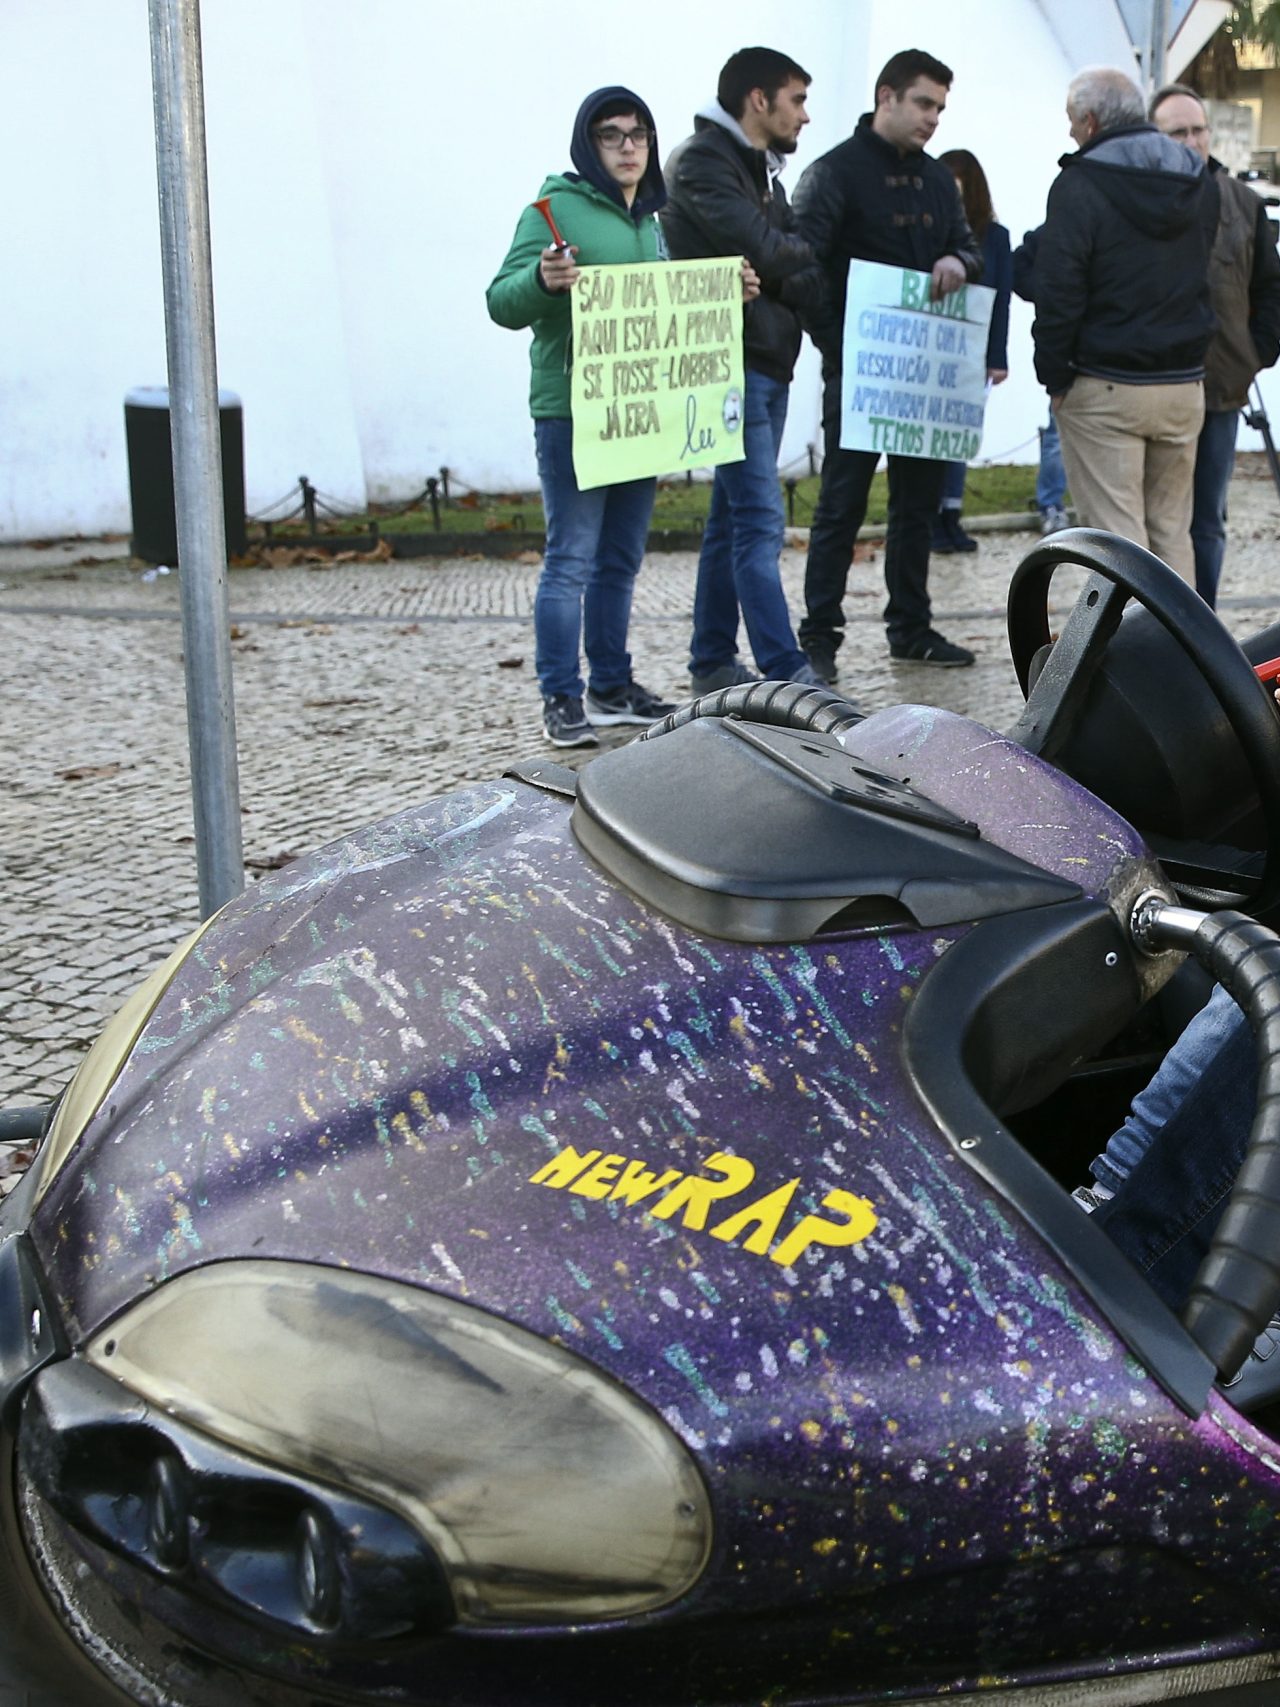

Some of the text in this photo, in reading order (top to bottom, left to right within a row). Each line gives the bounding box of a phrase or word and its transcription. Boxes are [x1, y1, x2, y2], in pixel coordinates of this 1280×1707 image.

[578, 266, 735, 312] SÃO UMA VERGONHA
[578, 307, 734, 357] AQUI ESTÁ A PROVA
[583, 363, 604, 400] SE
[612, 357, 659, 397] FOSSE
[857, 351, 959, 389] RESOLUÇÃO QUE
[600, 399, 661, 441] JÁ ERA
[869, 417, 980, 459] TEMOS RAZÃO
